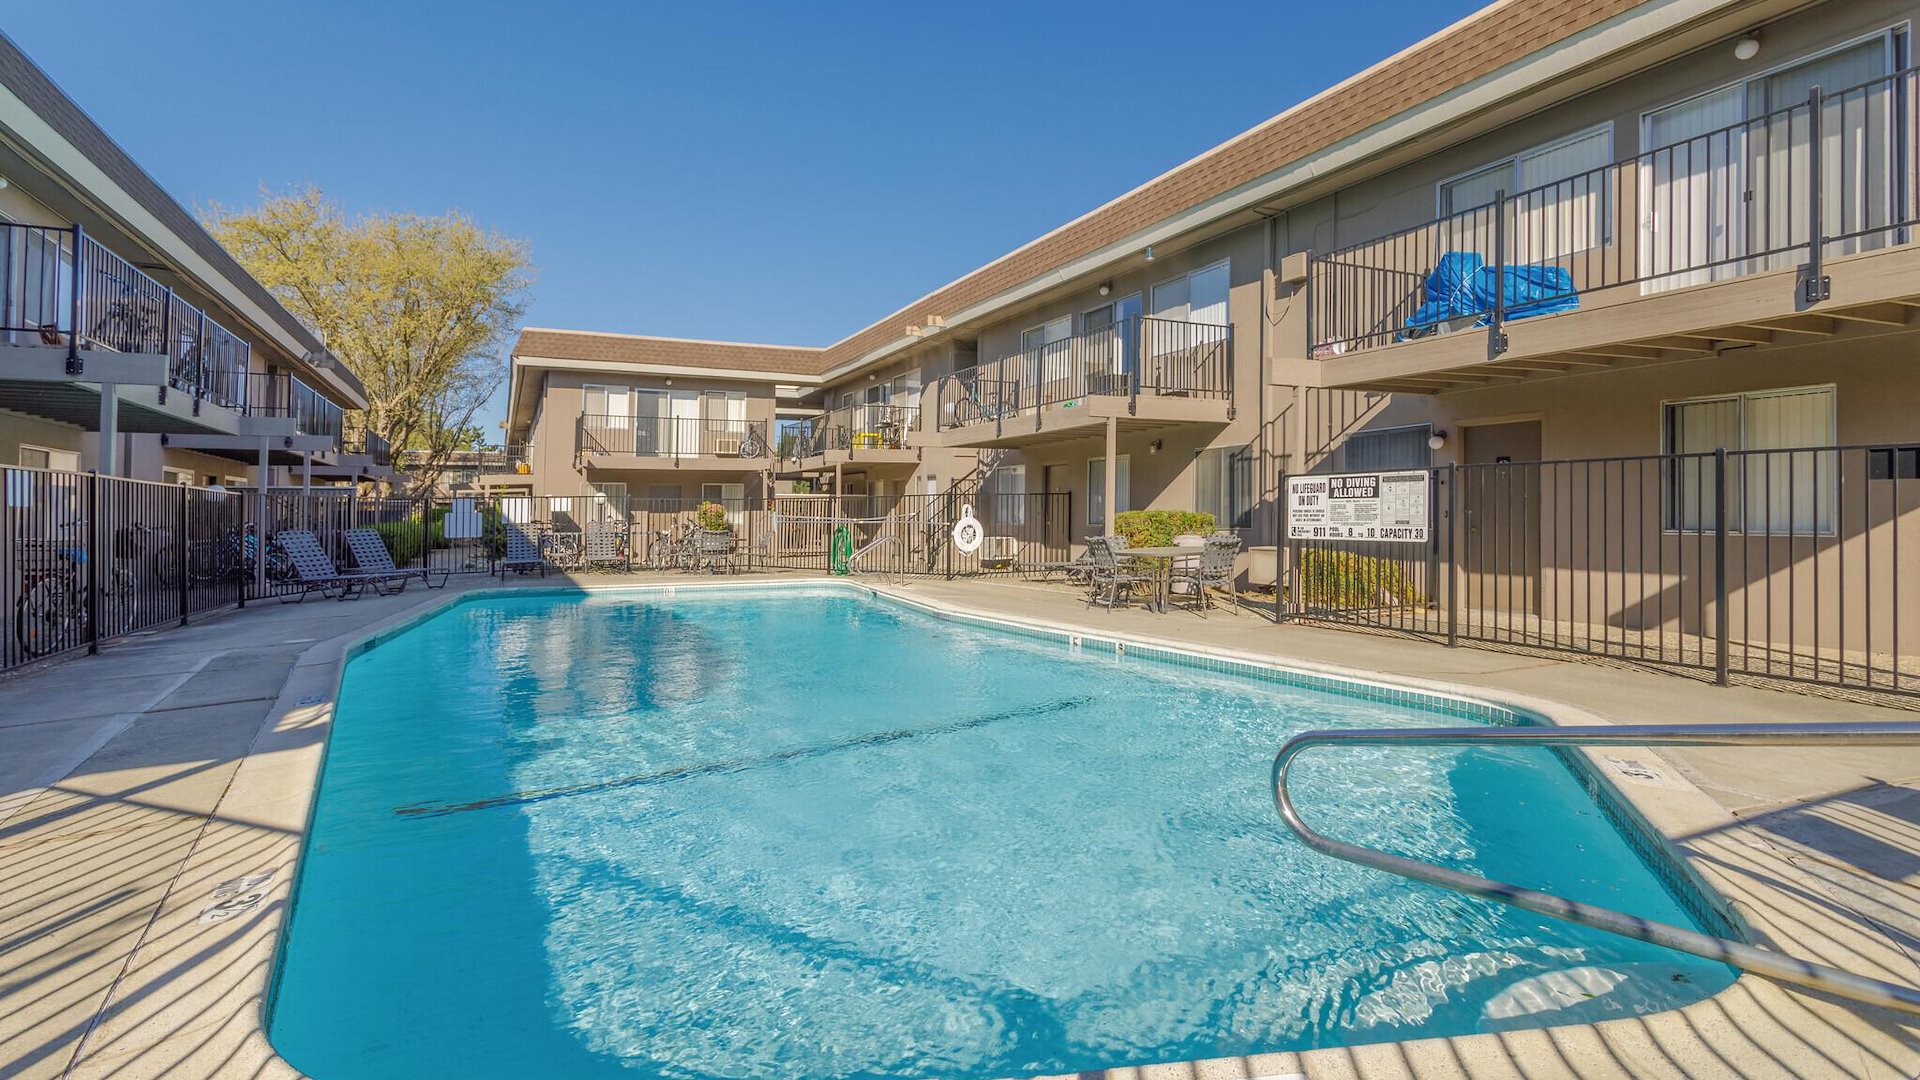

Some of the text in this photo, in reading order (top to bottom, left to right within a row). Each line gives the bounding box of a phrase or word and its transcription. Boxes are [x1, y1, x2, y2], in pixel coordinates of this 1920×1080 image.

[1331, 478, 1343, 488] NO
[1346, 476, 1376, 488] DIVING
[1292, 482, 1326, 494] NO LIFEGUARD
[1333, 487, 1374, 498] ALLOWED
[1298, 495, 1319, 506] ON DUTY
[1313, 527, 1326, 537] 911
[1348, 527, 1353, 537] 8
[1367, 527, 1375, 537] 10
[1380, 528, 1424, 539] CAPACITY 30
